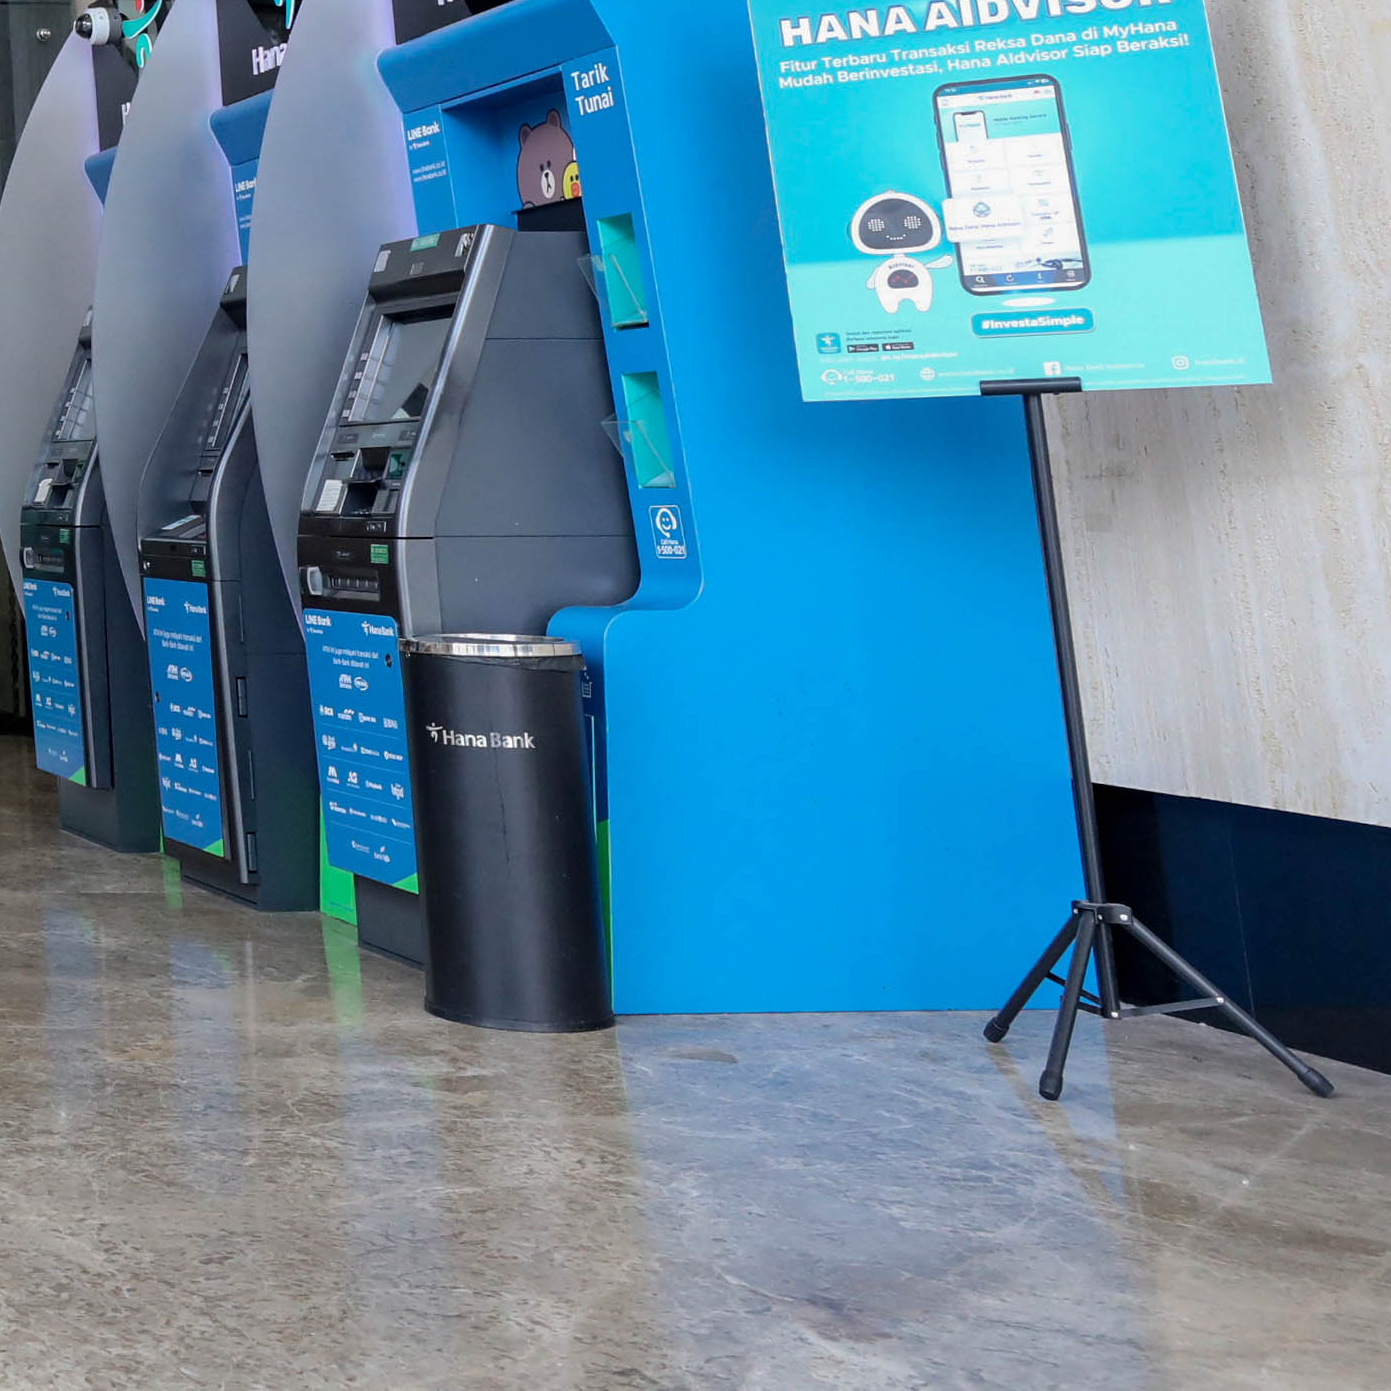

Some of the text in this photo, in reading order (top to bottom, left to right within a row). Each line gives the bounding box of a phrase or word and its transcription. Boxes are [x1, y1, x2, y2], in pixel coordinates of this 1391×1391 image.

[780, 5, 917, 48] HANA
[779, 73, 834, 89] Mudah
[837, 63, 943, 83] Berinvestasi,
[947, 57, 991, 72] Hana
[1072, 43, 1112, 58] Siap
[1117, 33, 1189, 53] Beraksi!
[780, 20, 1177, 73] Fitur Terbaru Transaksi Reksa Dana di MyHana
[571, 62, 609, 91] Tarik
[575, 86, 614, 116] Tunai
[407, 121, 440, 141] LINE Bank
[982, 315, 1085, 331] #InvestaSimple
[443, 729, 536, 748] Hana Bank
